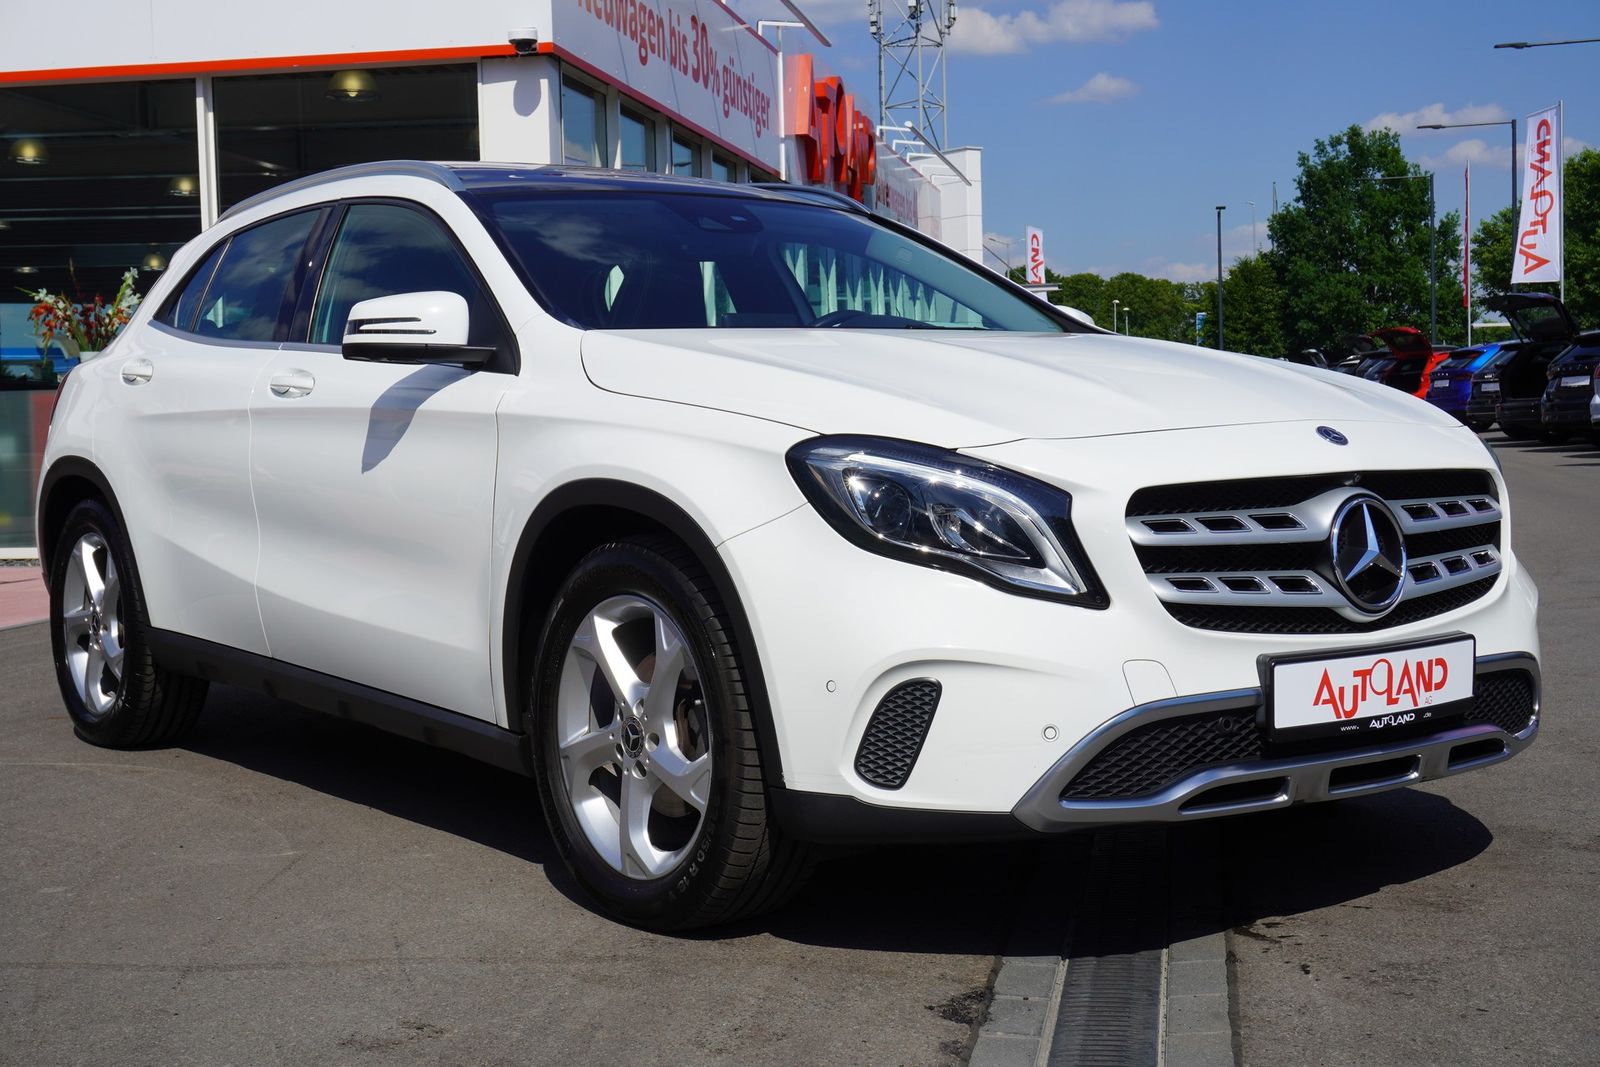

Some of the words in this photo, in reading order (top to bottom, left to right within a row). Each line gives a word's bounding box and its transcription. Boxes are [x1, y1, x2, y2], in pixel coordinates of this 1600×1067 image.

[578, 0, 666, 66] uwagen
[668, 8, 689, 76] bis
[690, 15, 720, 98] 30%
[722, 55, 770, 138] günstiger
[1312, 658, 1448, 720] AUTOLAND
[1369, 712, 1416, 729] AUTOLAND
